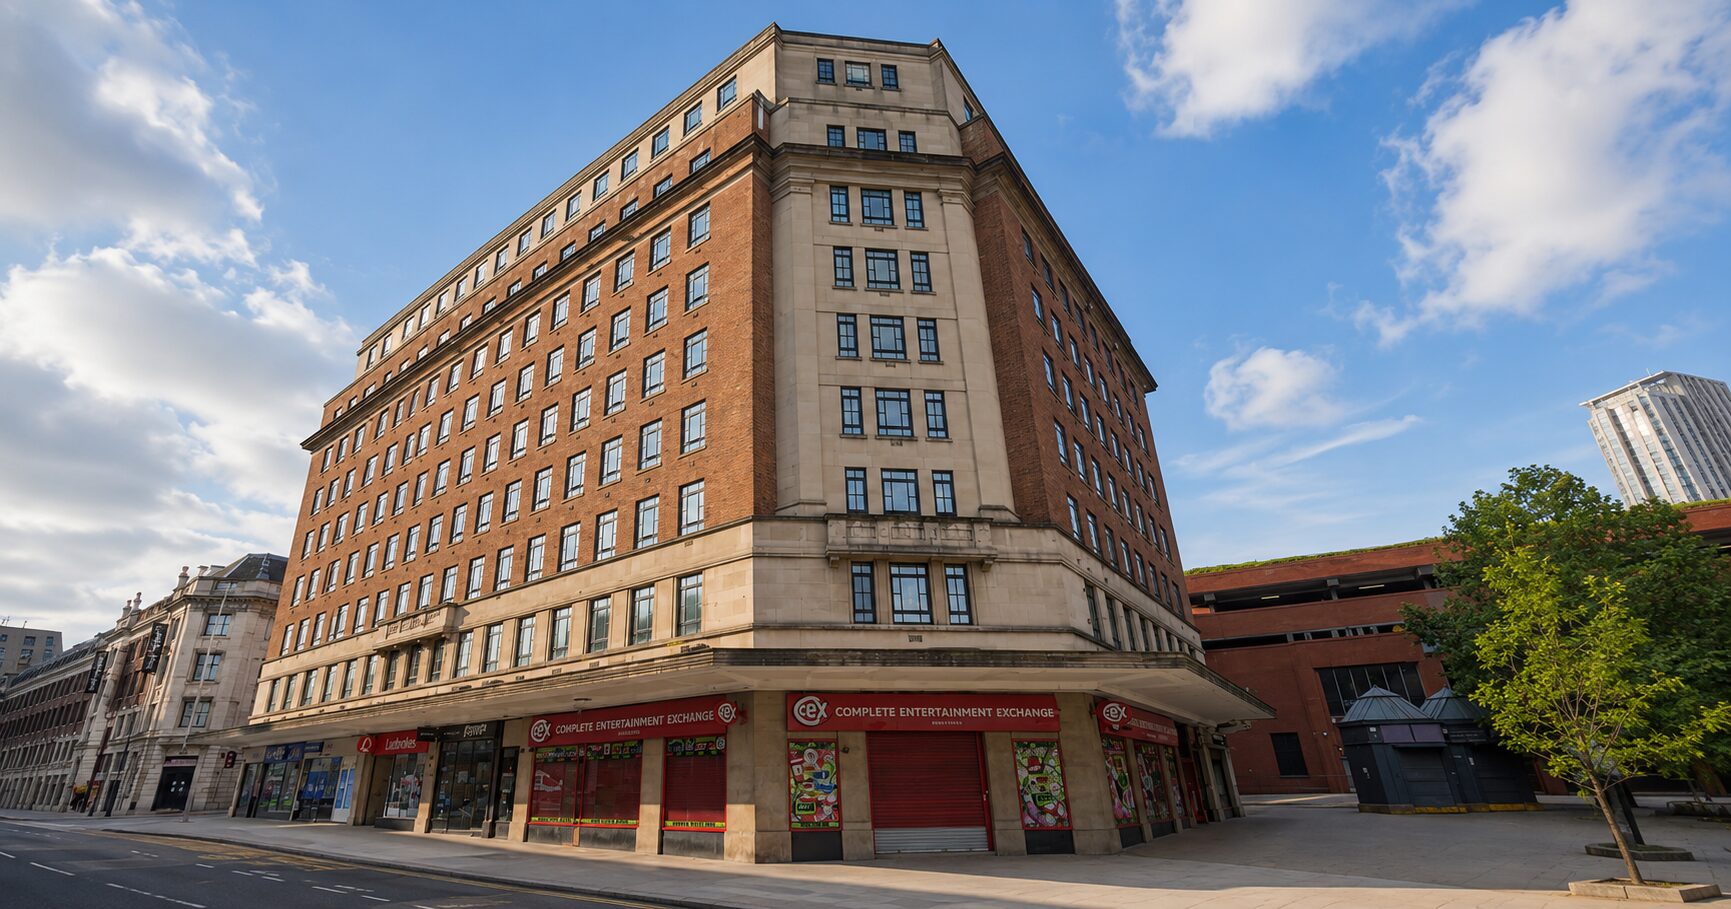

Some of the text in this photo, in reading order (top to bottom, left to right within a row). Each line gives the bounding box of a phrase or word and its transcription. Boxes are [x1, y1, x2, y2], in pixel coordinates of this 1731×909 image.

[835, 706, 1055, 718] COMPLETE ENTERTAINMENT EXCHANGE
[555, 710, 715, 735] COMPLETE ENTERTAINMENT EXCHANGE
